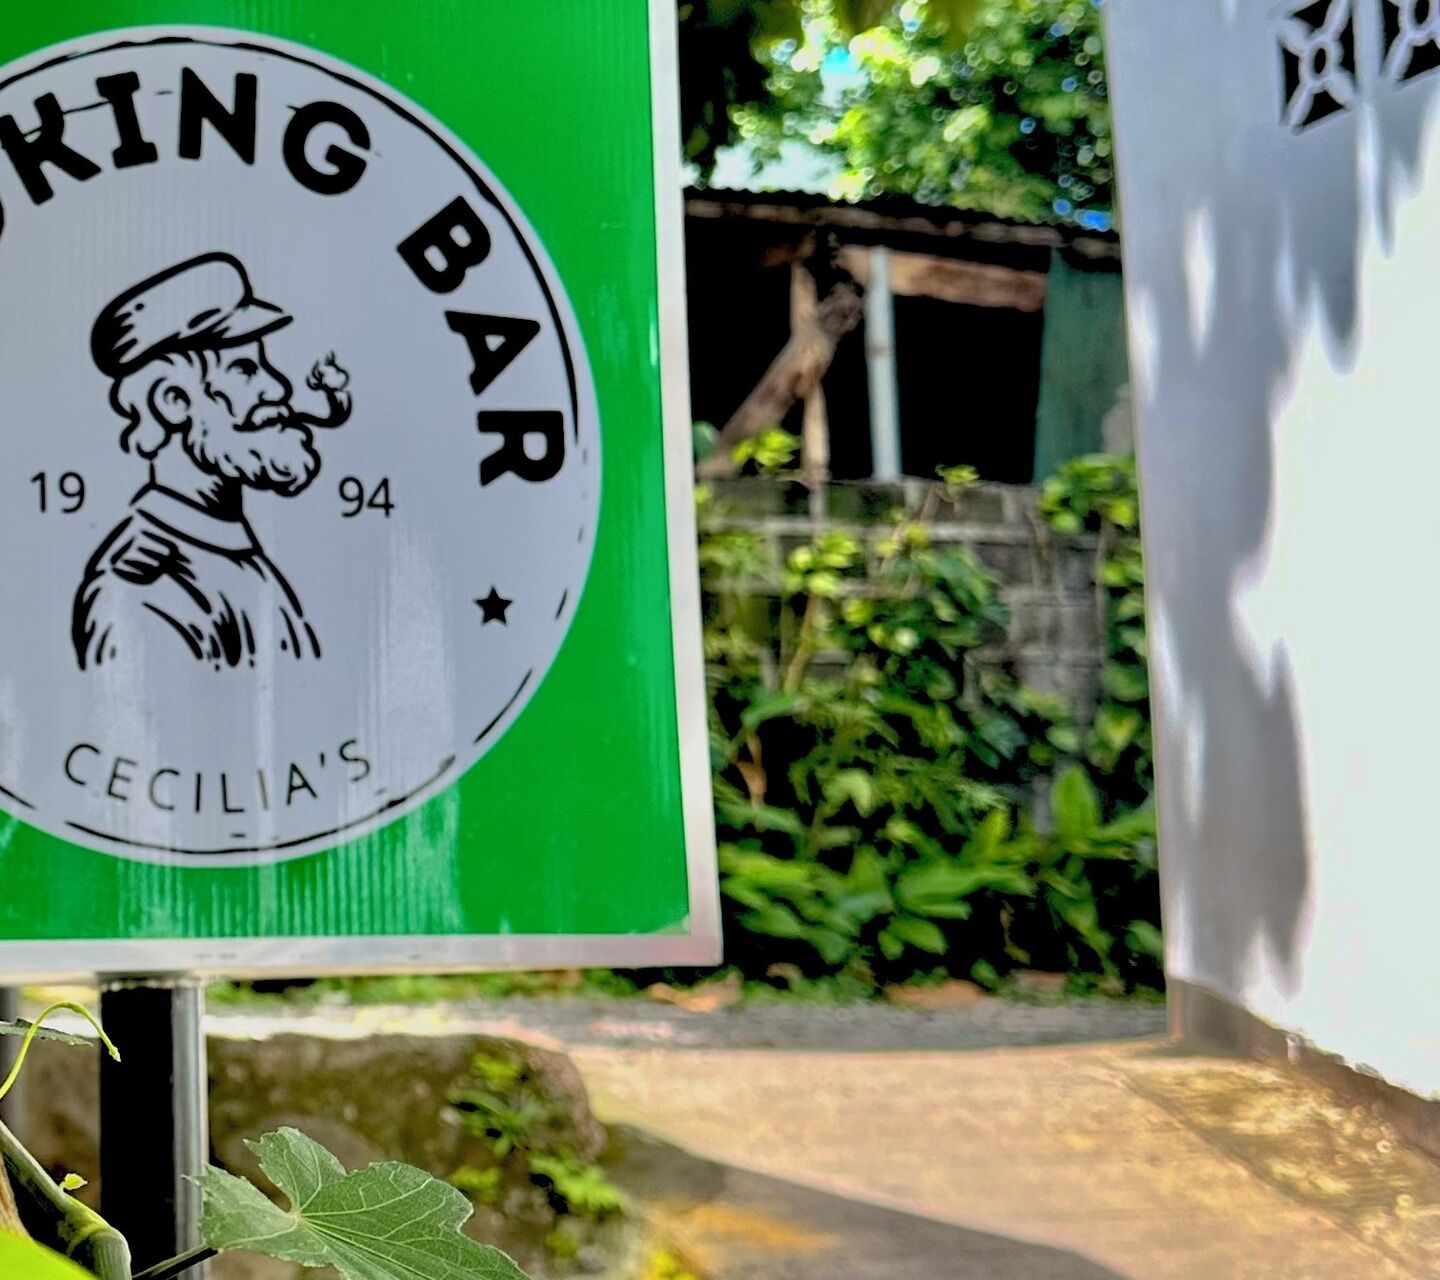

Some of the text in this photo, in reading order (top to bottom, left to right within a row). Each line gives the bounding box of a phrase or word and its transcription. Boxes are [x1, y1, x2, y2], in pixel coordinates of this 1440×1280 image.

[396, 195, 565, 488] BAR
[29, 471, 396, 520] 19 94
[62, 738, 372, 815] CECILIA'S
